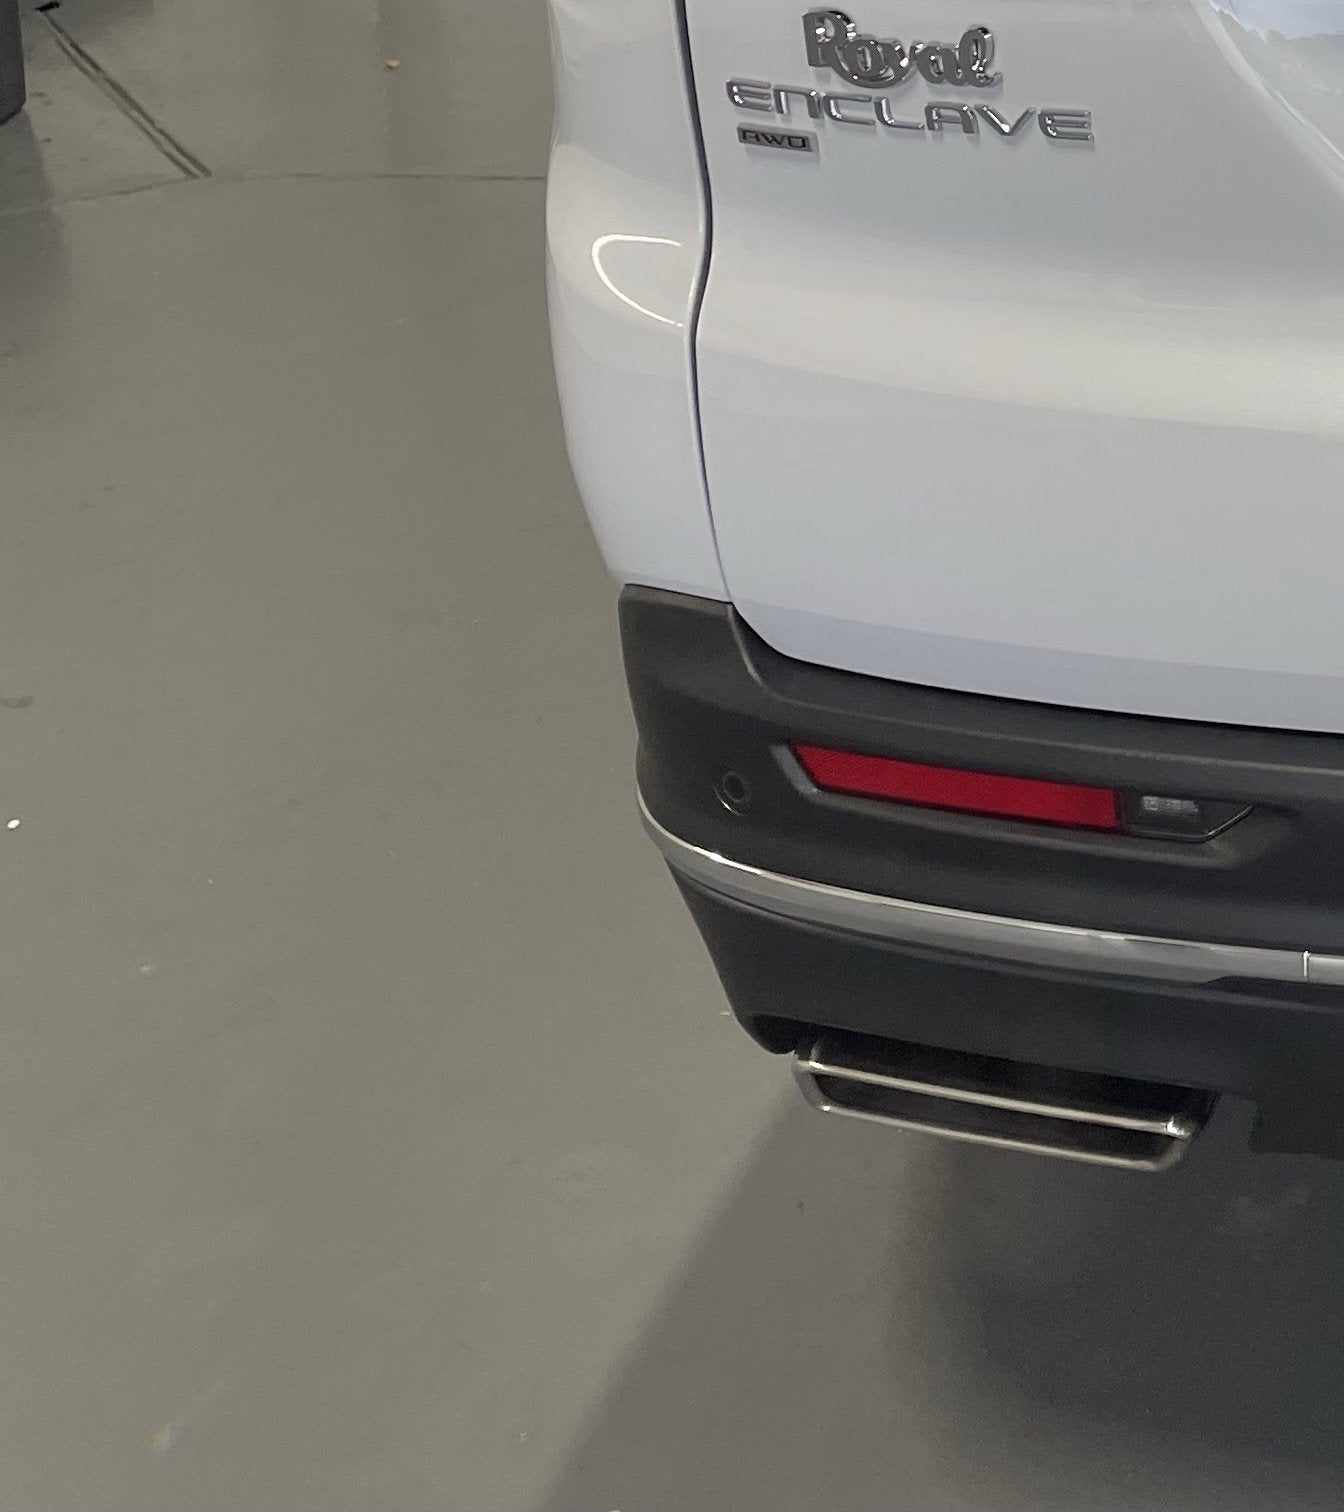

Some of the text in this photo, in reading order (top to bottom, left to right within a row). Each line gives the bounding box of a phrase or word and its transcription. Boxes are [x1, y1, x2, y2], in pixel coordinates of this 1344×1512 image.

[802, 7, 1003, 89] Royal
[725, 77, 1095, 143] ENCLAVE
[741, 129, 807, 149] AWD
